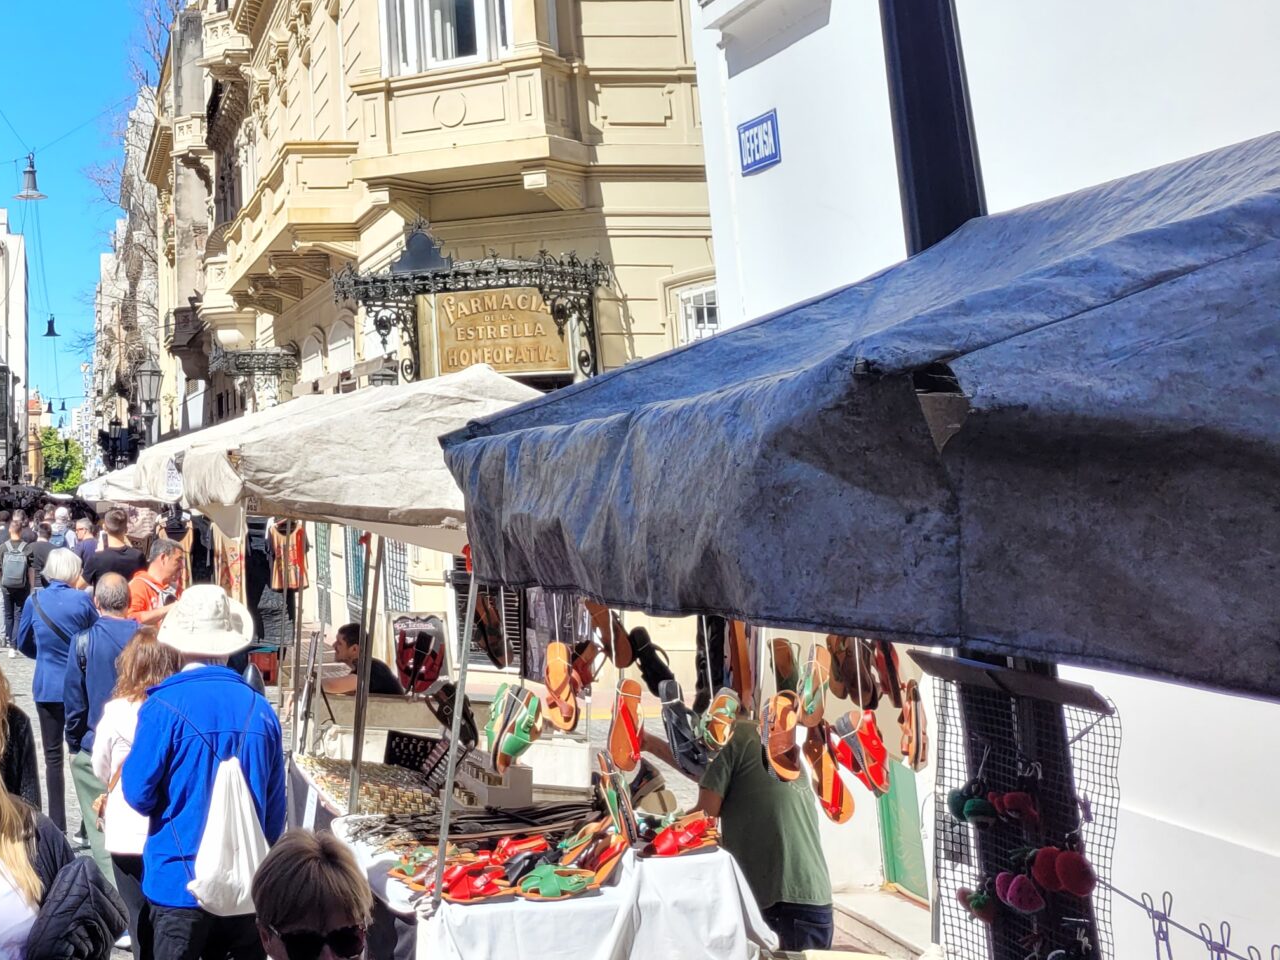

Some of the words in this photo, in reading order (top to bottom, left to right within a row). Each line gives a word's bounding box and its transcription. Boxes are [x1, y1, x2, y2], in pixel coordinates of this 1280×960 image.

[741, 120, 776, 166] DEFENSA
[442, 294, 553, 327] FARMACIA
[484, 314, 497, 323] DE
[502, 312, 515, 321] LA
[456, 322, 547, 341] ESTRELLA
[447, 345, 558, 367] HOMEOPATIA
